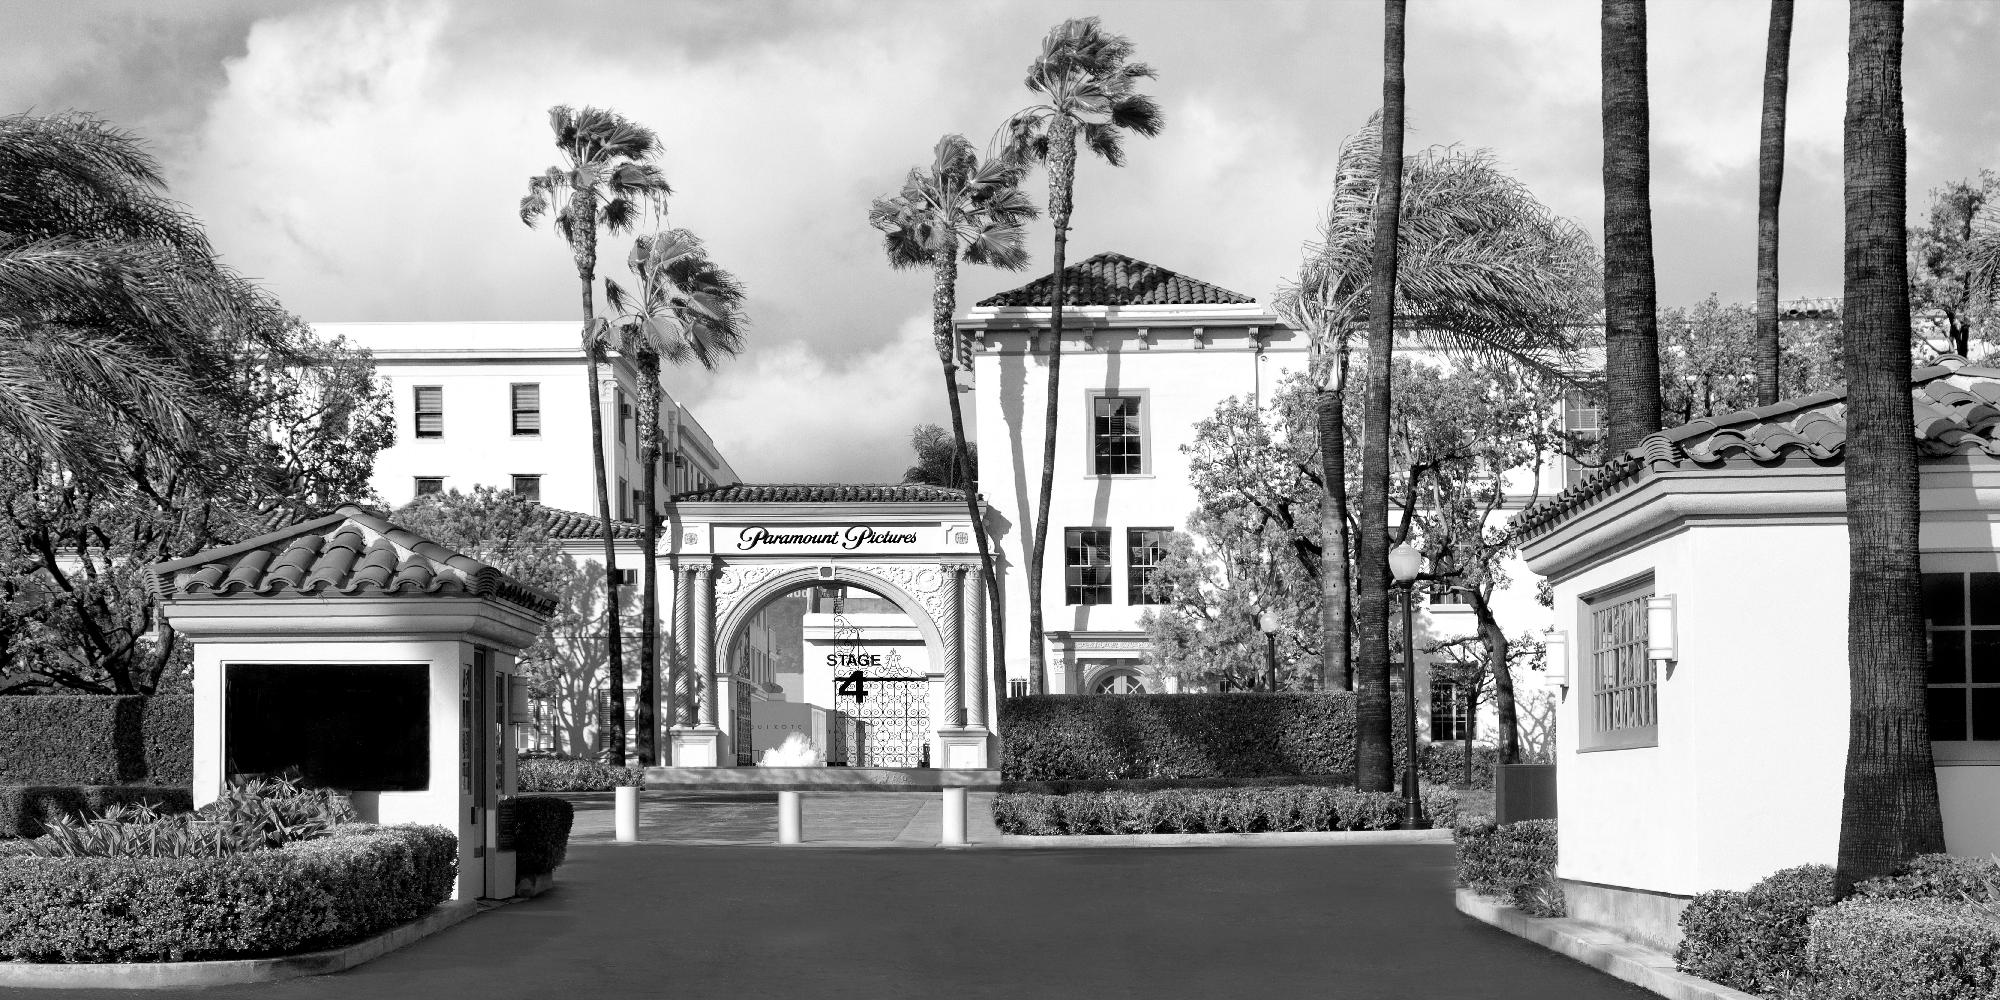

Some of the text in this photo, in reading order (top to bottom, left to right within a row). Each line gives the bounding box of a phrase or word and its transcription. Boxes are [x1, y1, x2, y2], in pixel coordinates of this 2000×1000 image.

[737, 525, 917, 550] Paramount Pictures
[827, 654, 881, 666] STAGE
[839, 671, 868, 703] 4
